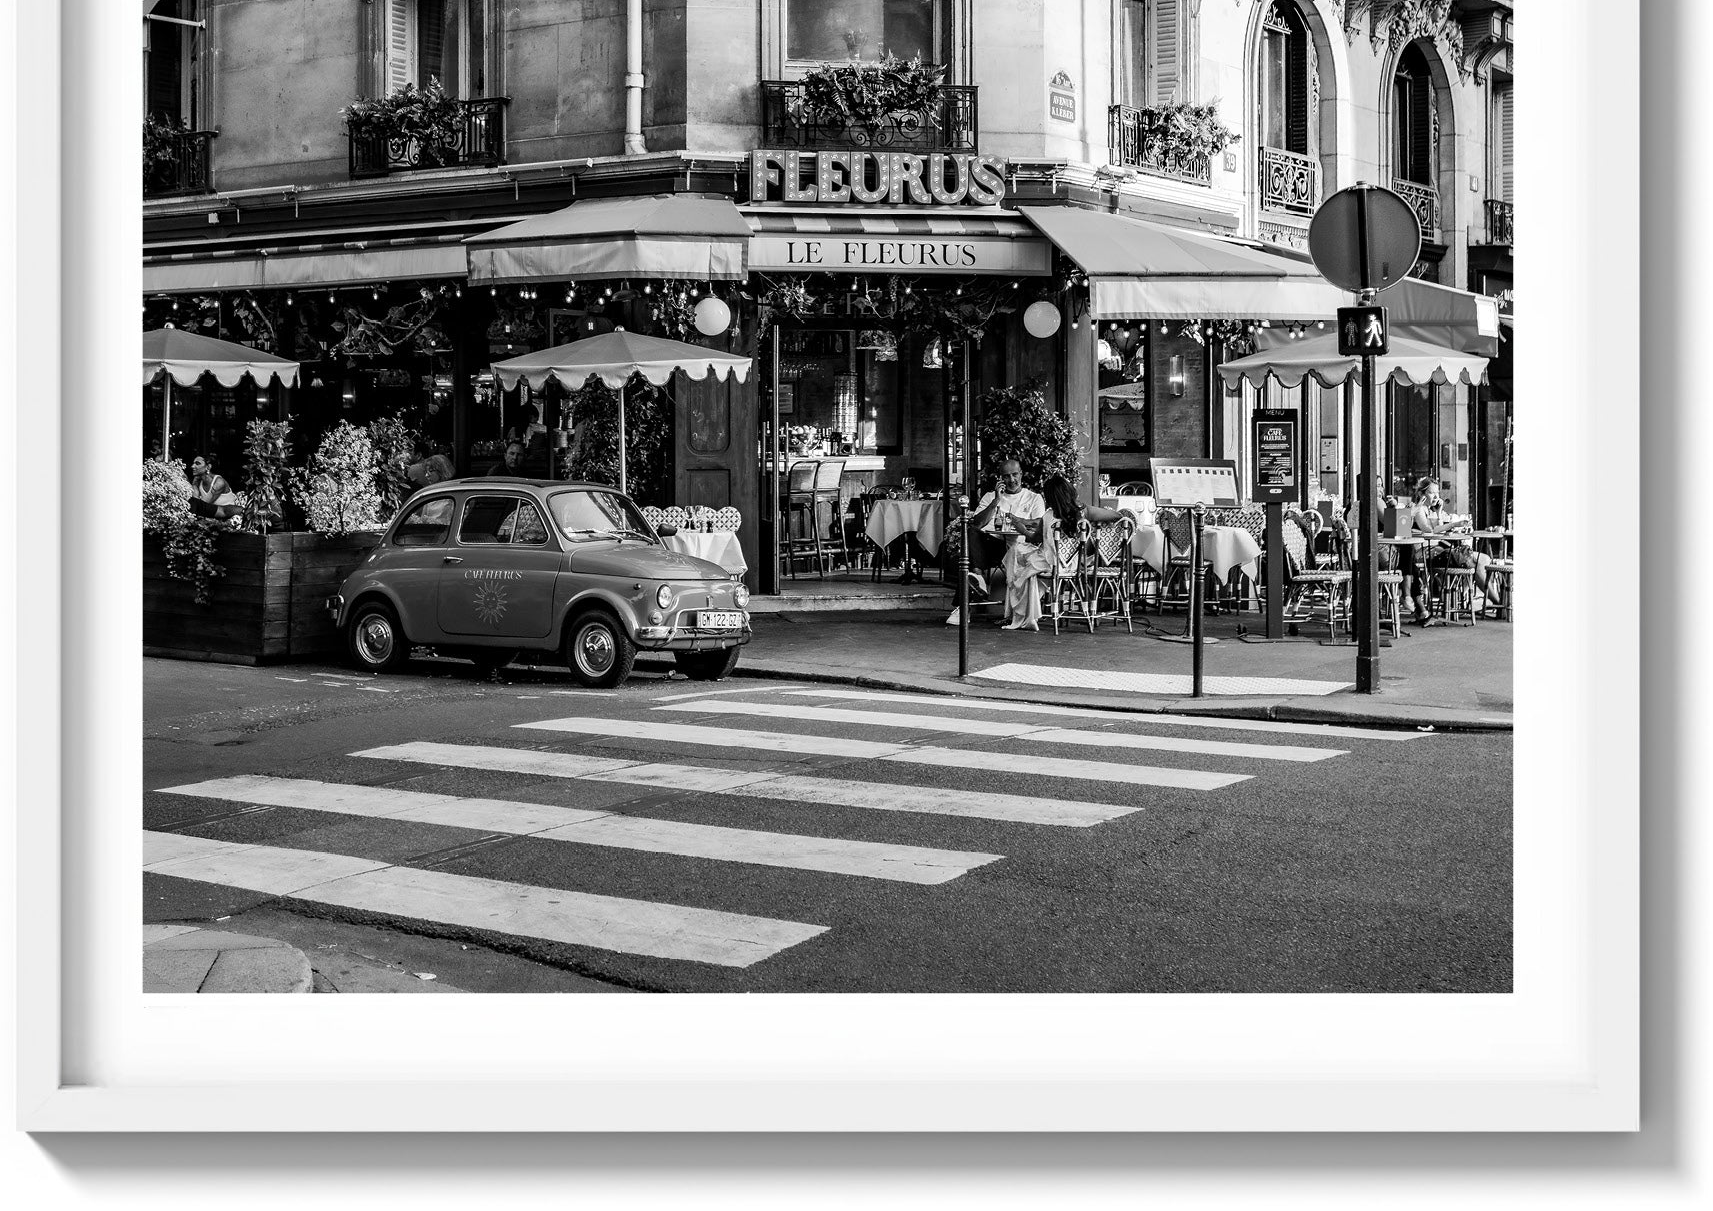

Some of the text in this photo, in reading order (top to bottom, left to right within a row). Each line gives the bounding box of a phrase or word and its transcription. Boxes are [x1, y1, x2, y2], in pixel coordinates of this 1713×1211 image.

[1052, 95, 1074, 109] AVENUE
[1226, 154, 1235, 171] 39
[752, 149, 1006, 205] FLEURUS
[786, 241, 976, 266] LE FLEURUS
